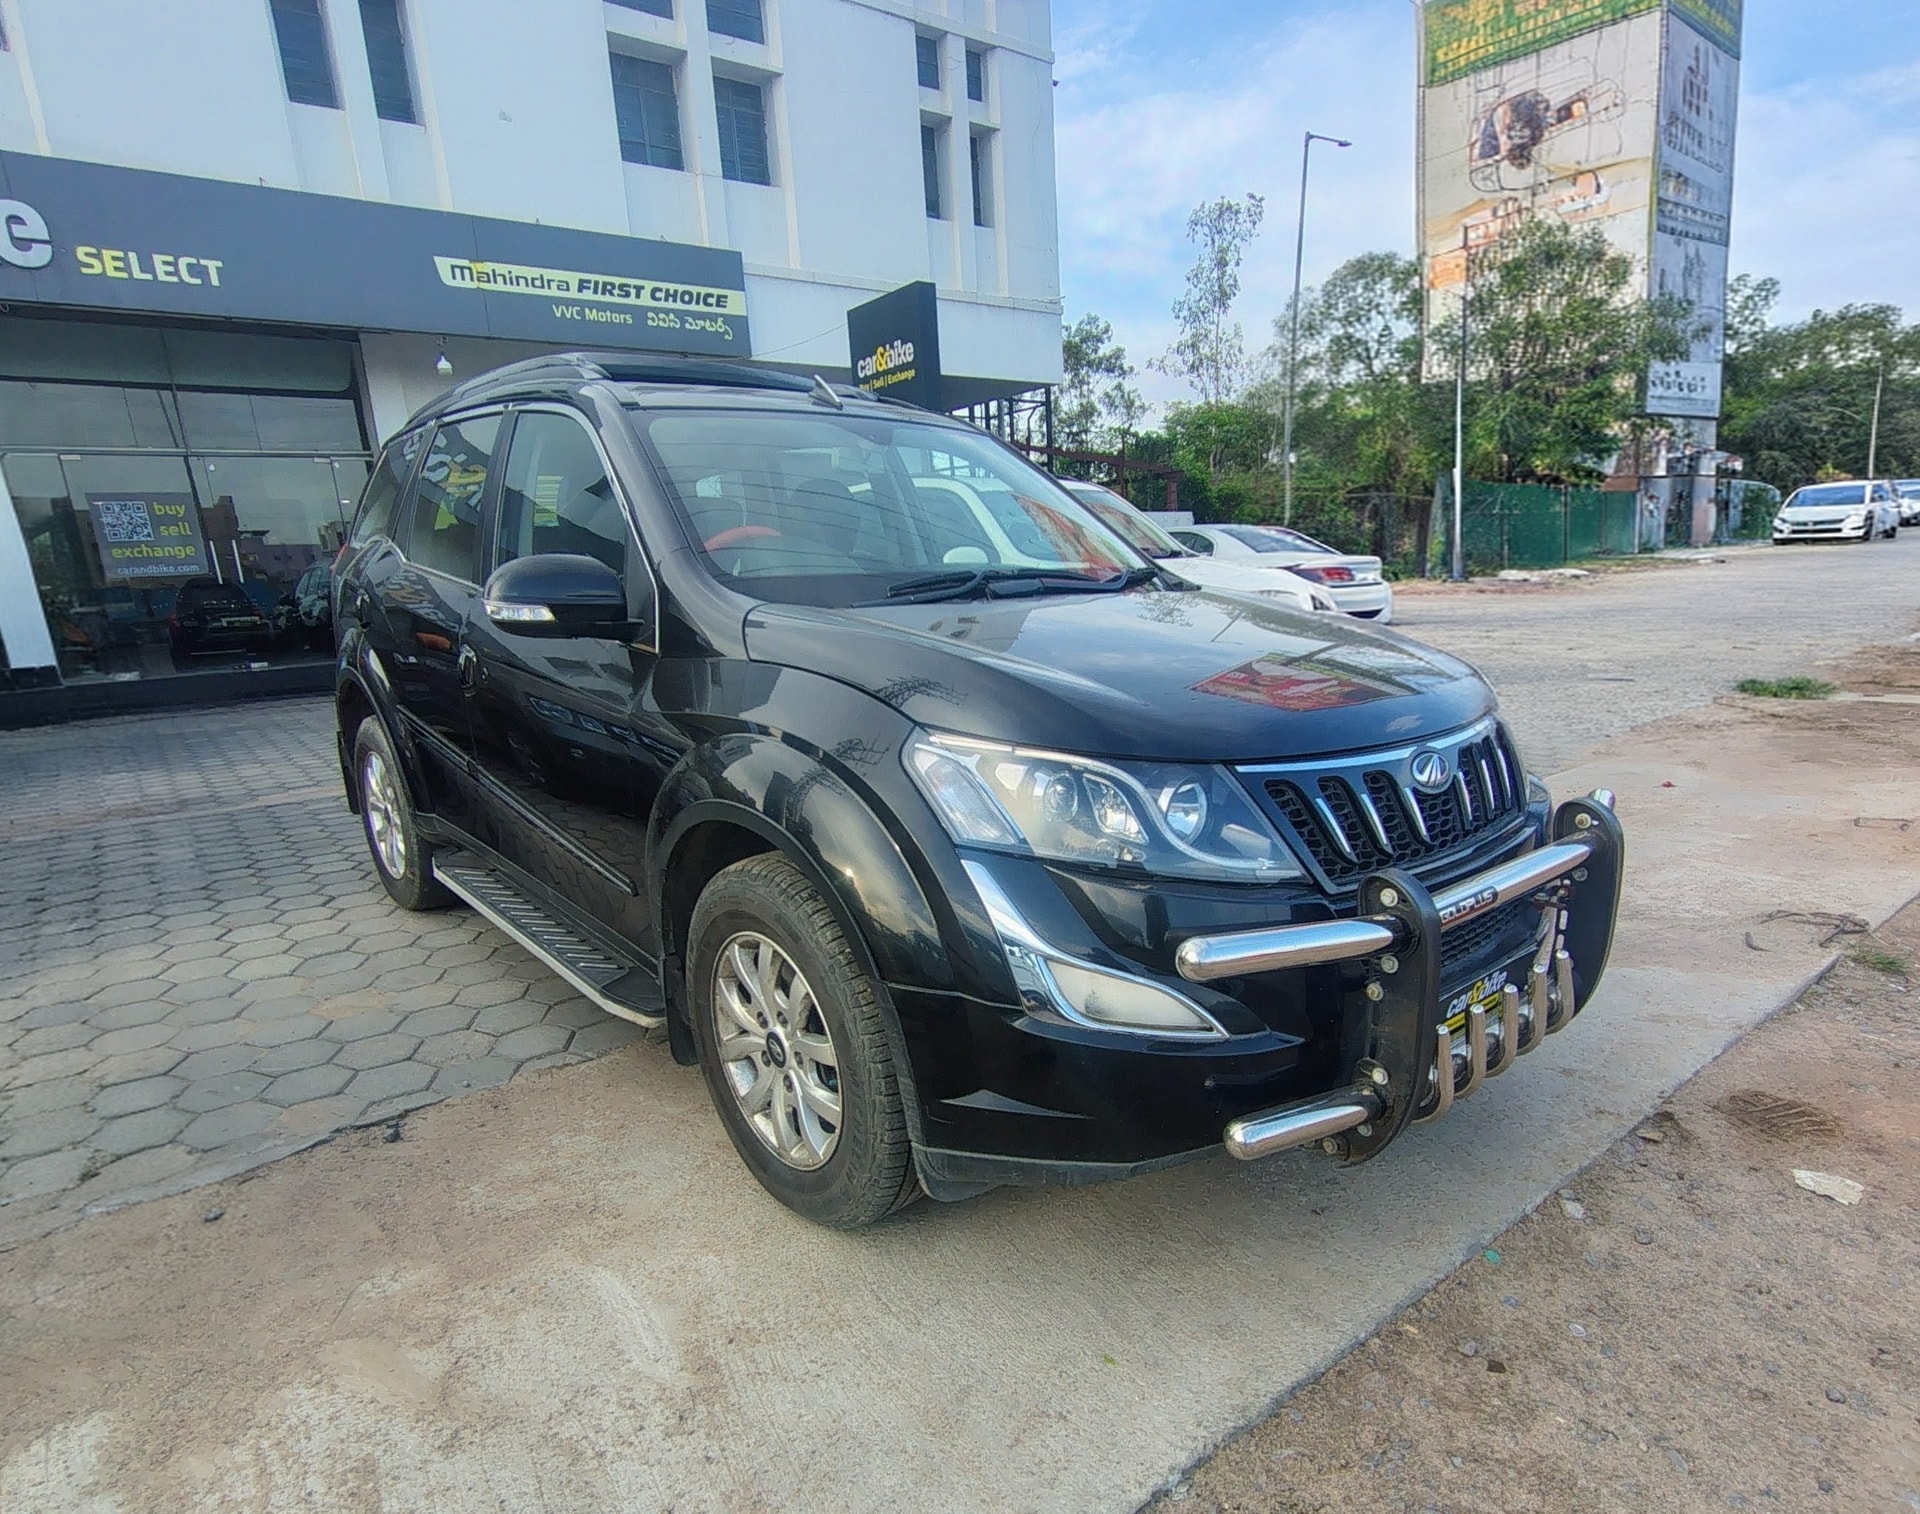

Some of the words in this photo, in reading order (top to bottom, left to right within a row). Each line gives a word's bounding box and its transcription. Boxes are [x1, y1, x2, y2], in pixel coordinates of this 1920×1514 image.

[75, 246, 224, 287] SELECT
[577, 279, 645, 300] FIRST
[650, 286, 728, 309] CHOICE
[552, 304, 582, 320] VVC
[585, 307, 633, 324] Motors
[857, 339, 914, 378] car&bike
[873, 376, 884, 389] Sell
[887, 368, 916, 385] Exchange
[153, 501, 186, 517] buy
[160, 521, 193, 536] sell
[111, 543, 196, 559] exchange
[118, 563, 200, 575] carandbike.com
[1446, 970, 1508, 1018] car&bike
